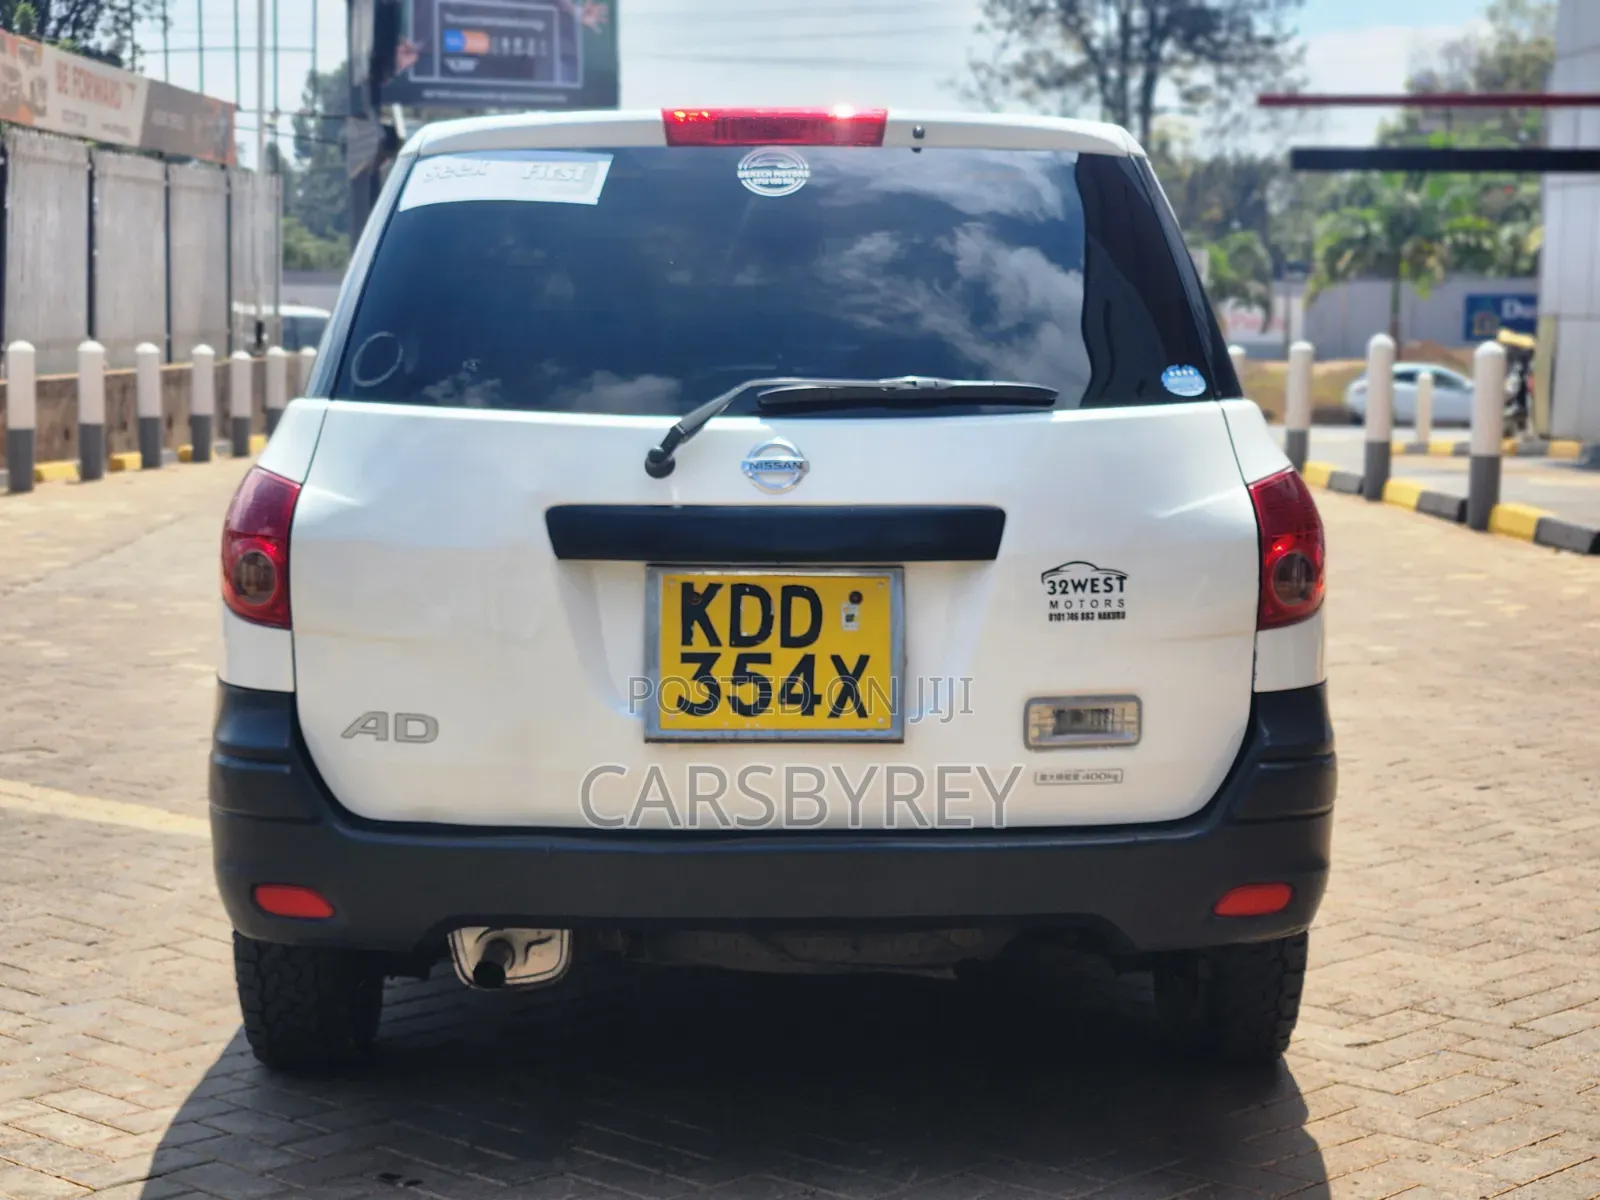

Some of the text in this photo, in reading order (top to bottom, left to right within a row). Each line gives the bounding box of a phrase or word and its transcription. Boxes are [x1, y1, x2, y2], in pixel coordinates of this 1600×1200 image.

[748, 461, 804, 471] NISSAN
[1047, 576, 1128, 596] 32WEST
[680, 581, 824, 649] KDD
[1049, 599, 1126, 610] MOTORS
[676, 651, 871, 719] 354X
[340, 710, 440, 744] AD
